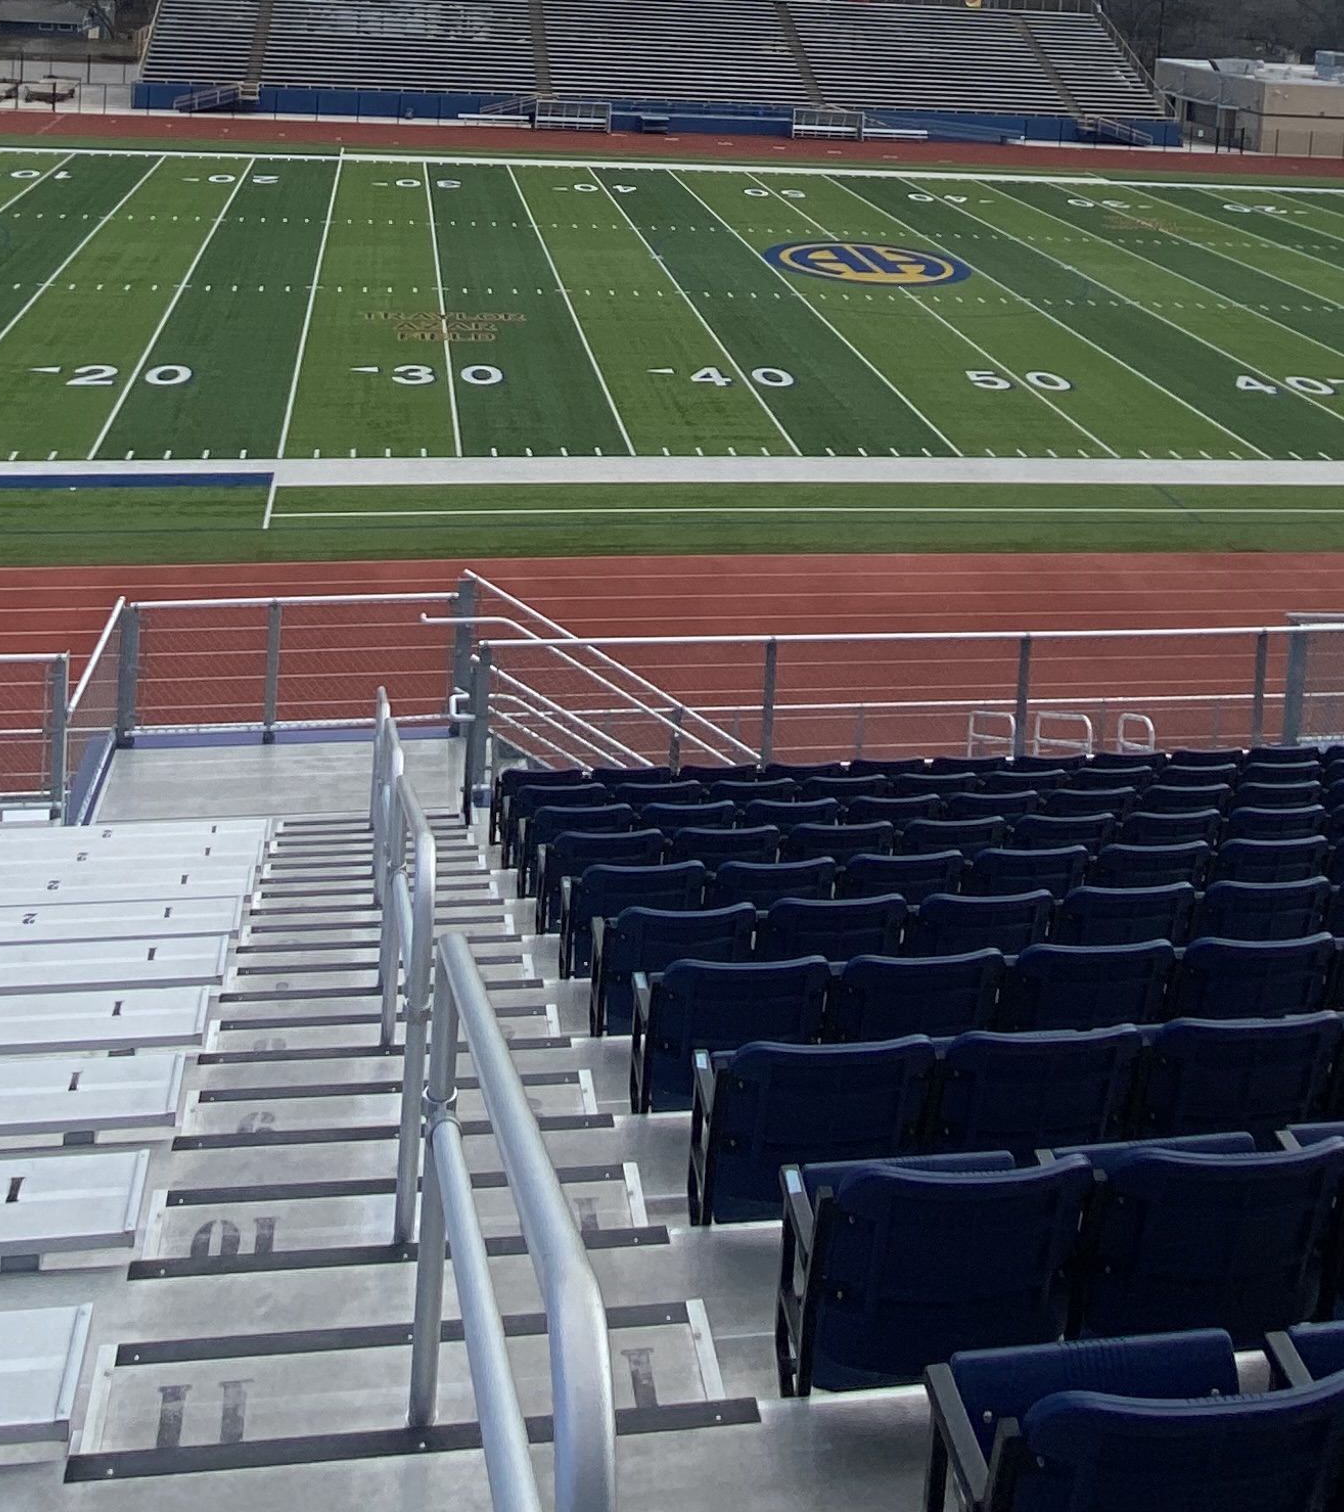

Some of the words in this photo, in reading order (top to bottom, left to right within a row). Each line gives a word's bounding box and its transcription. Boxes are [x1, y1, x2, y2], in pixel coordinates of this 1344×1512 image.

[10, 169, 72, 180] 10
[208, 174, 280, 185] 20
[395, 178, 462, 189] 30
[573, 183, 637, 194] 40
[743, 188, 807, 200] 50
[907, 192, 968, 204] 40
[66, 365, 193, 387] 20
[392, 364, 504, 386] 30
[690, 366, 795, 387] 40
[965, 370, 1072, 392] 50
[1236, 374, 1336, 396] 40
[76, 852, 88, 862] 2
[205, 847, 211, 856] 1
[47, 880, 61, 891] 2
[181, 874, 189, 885] 1
[164, 907, 173, 918] 1
[22, 913, 38, 925] 2
[147, 947, 158, 961] 1
[112, 1000, 125, 1017] 1
[68, 1071, 83, 1092] 1
[5, 1177, 26, 1204] 1
